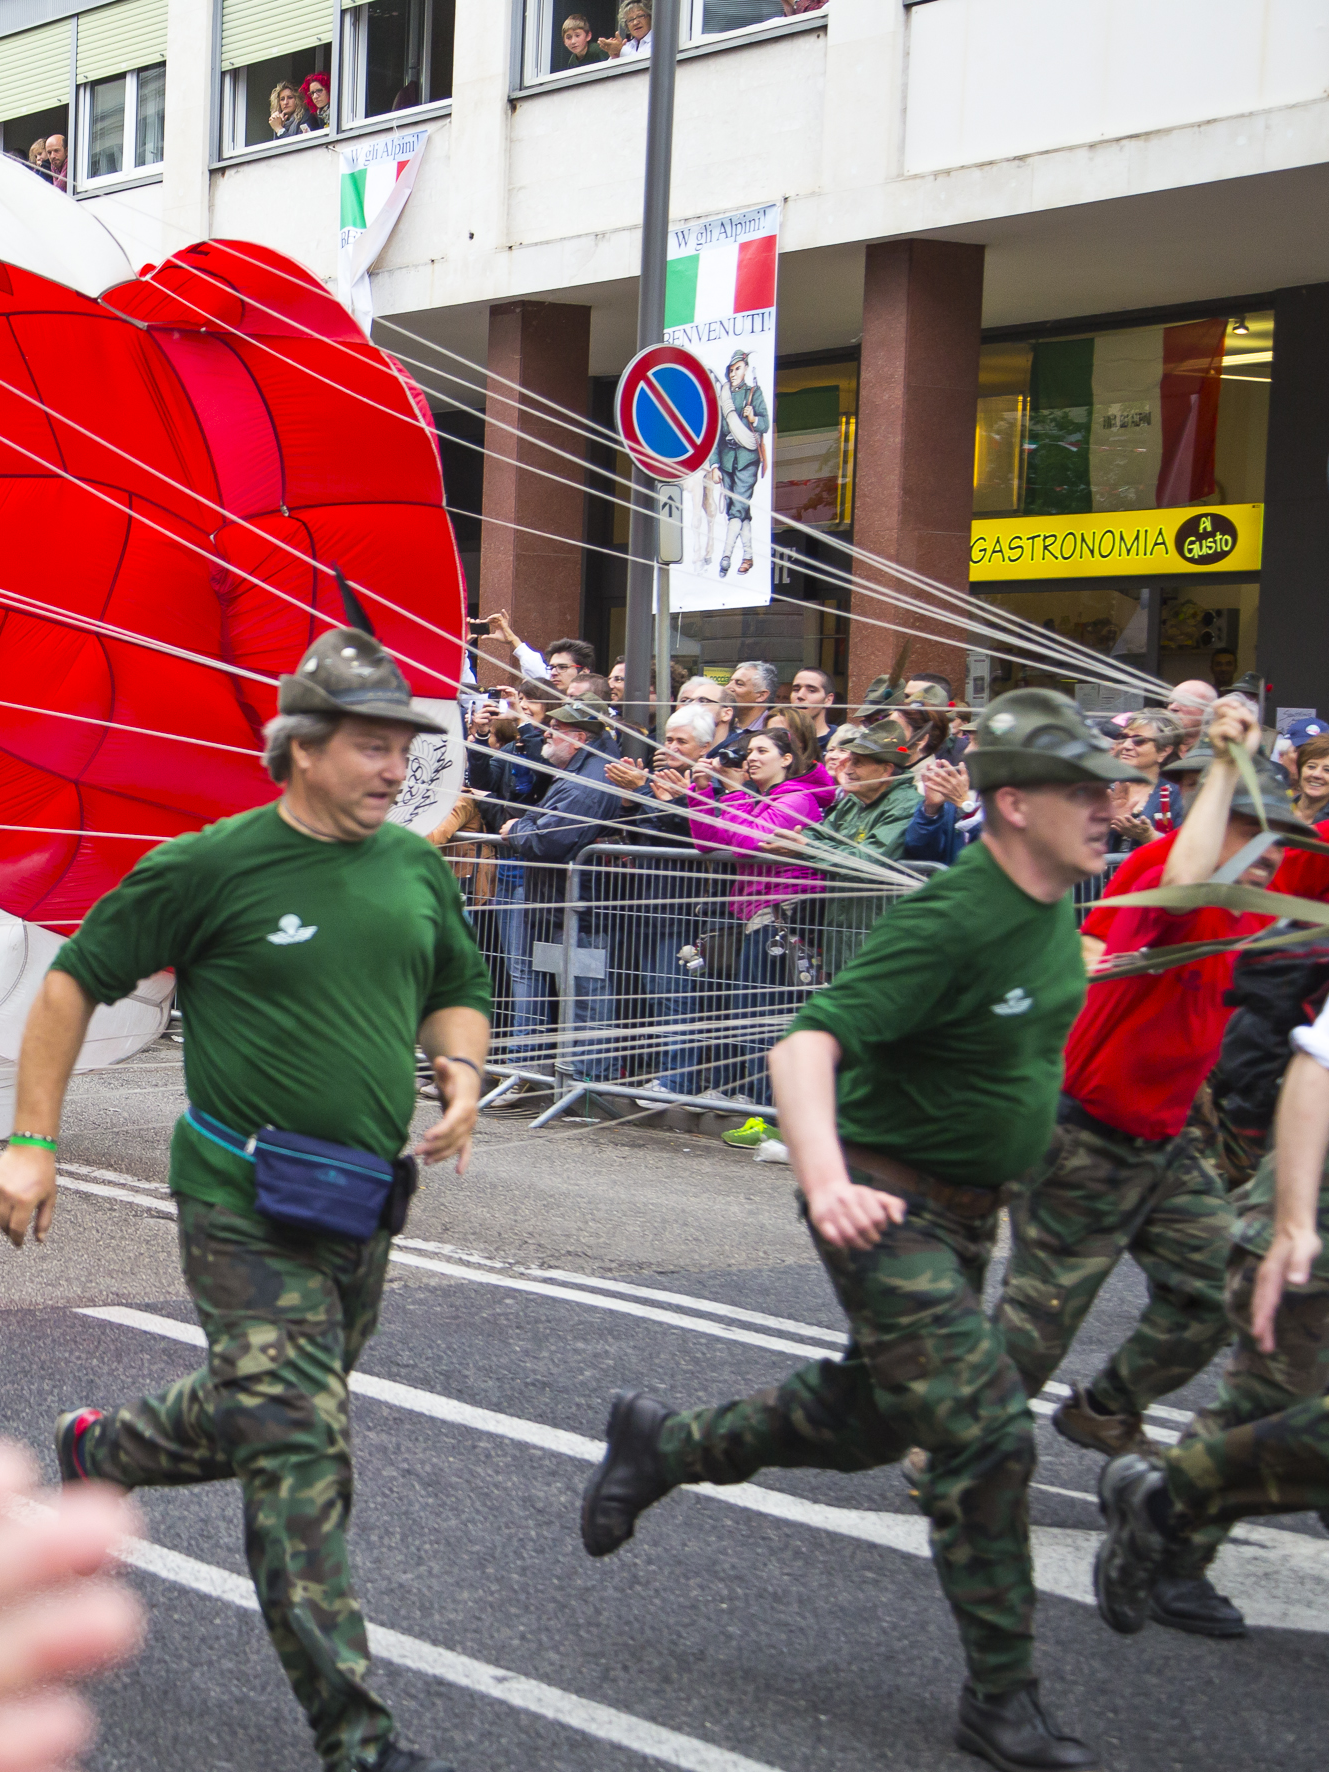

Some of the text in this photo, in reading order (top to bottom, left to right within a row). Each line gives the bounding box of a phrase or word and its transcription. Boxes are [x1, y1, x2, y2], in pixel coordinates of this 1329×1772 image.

[351, 148, 363, 165] W
[363, 142, 379, 167] gli
[674, 209, 767, 252] W gli Alpini!
[969, 527, 1233, 565] GASTRONOMIA Gusto
